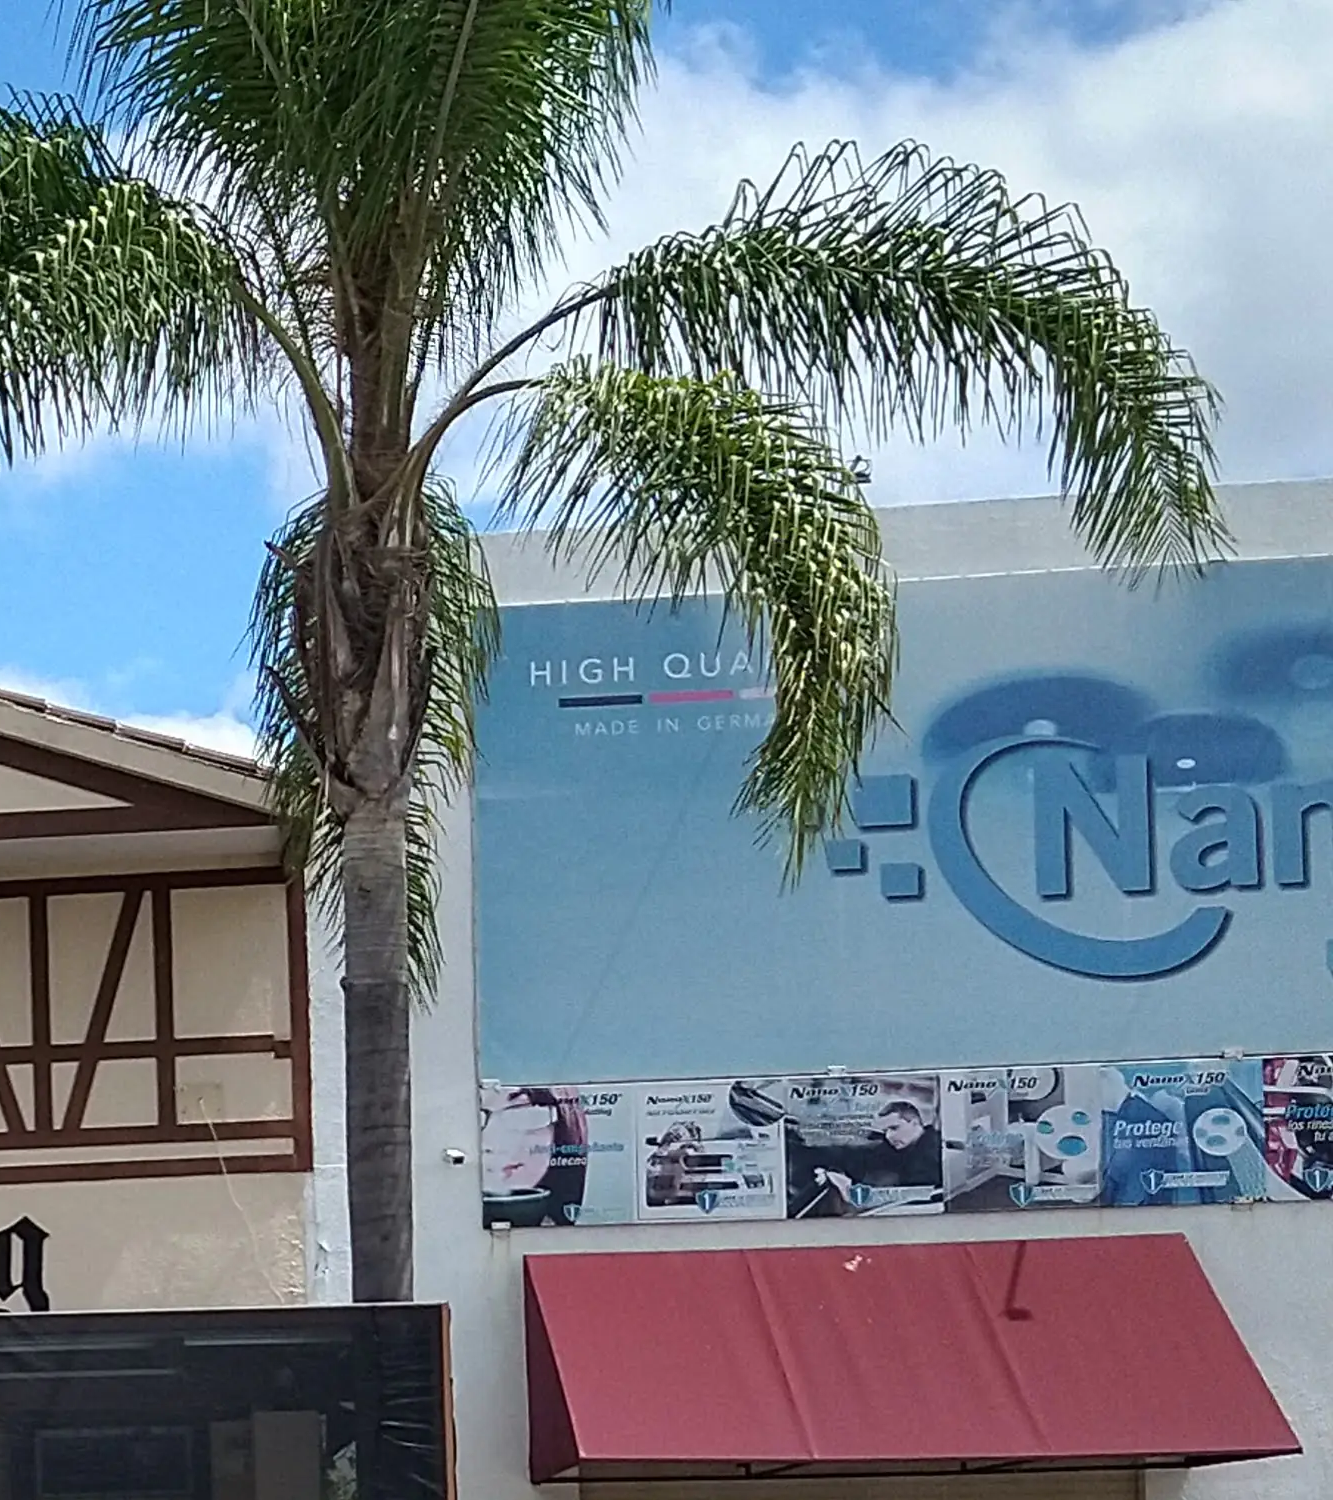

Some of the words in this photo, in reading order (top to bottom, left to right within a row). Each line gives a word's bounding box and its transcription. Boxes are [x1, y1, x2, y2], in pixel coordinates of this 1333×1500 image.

[529, 656, 636, 687] HIGH
[574, 719, 640, 736] MADE
[657, 719, 680, 733] IN
